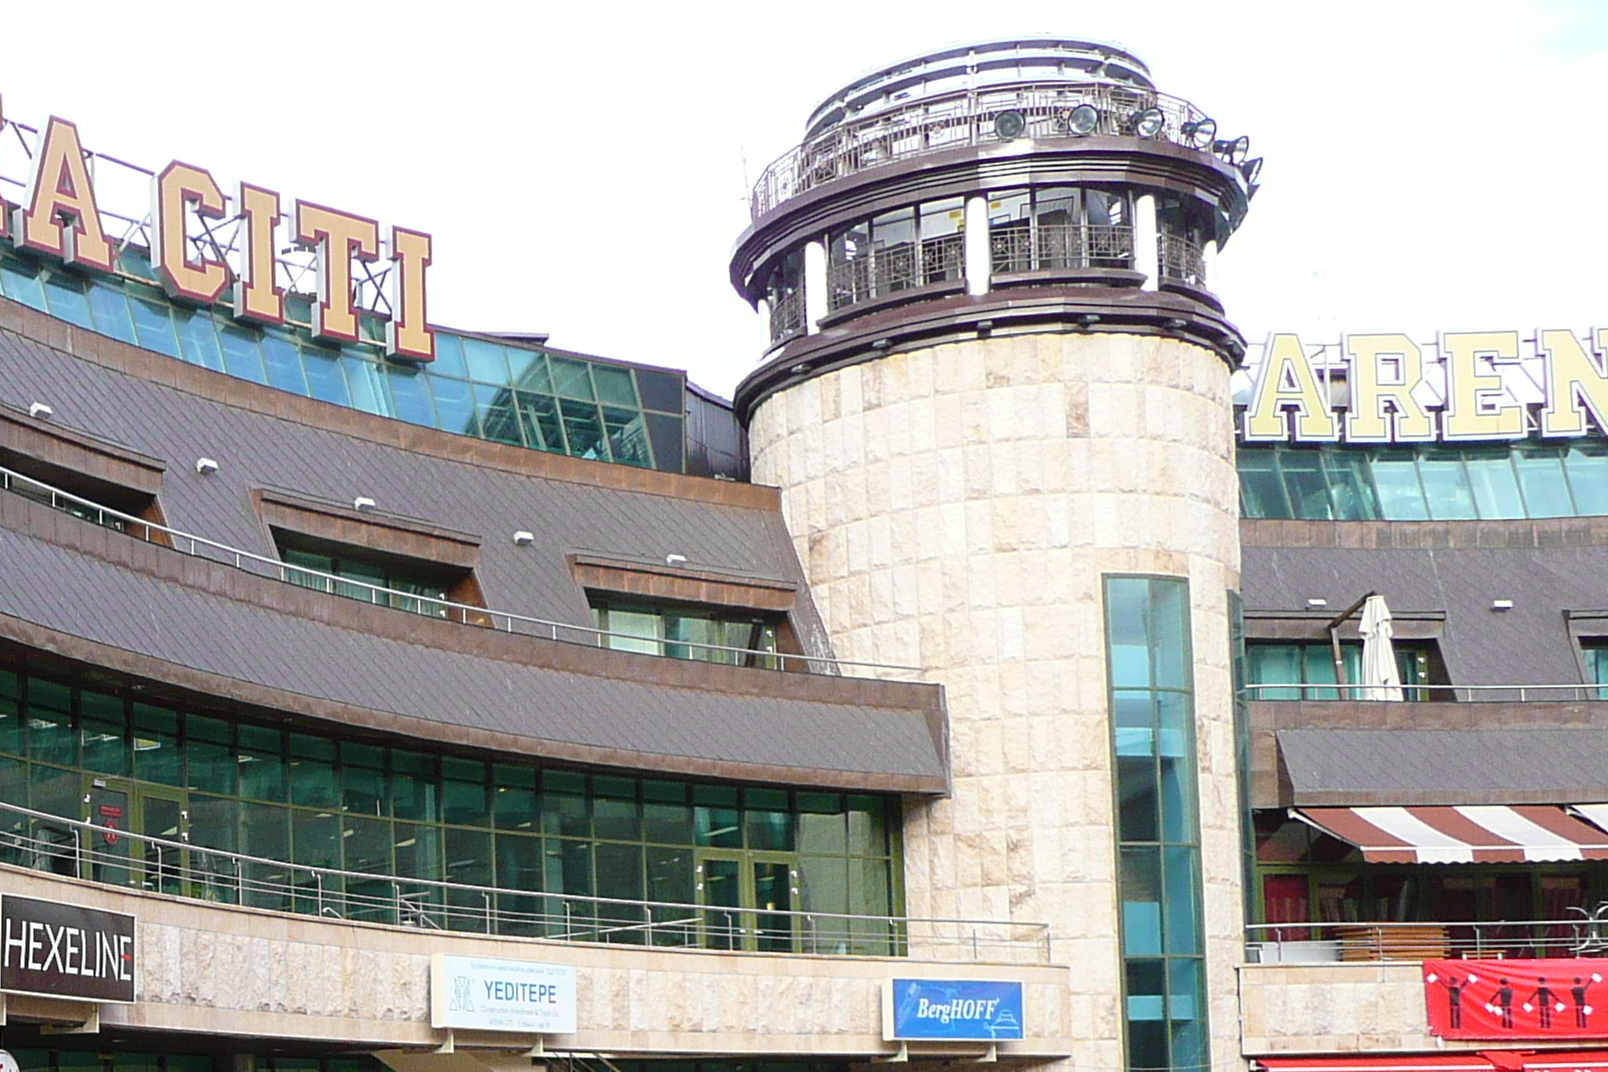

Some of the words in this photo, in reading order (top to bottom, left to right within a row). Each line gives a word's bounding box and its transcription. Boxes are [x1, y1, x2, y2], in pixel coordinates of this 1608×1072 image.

[151, 159, 436, 362] СІТІ
[4, 918, 133, 982] HEXELINE
[483, 979, 557, 1004] YEDITEPE
